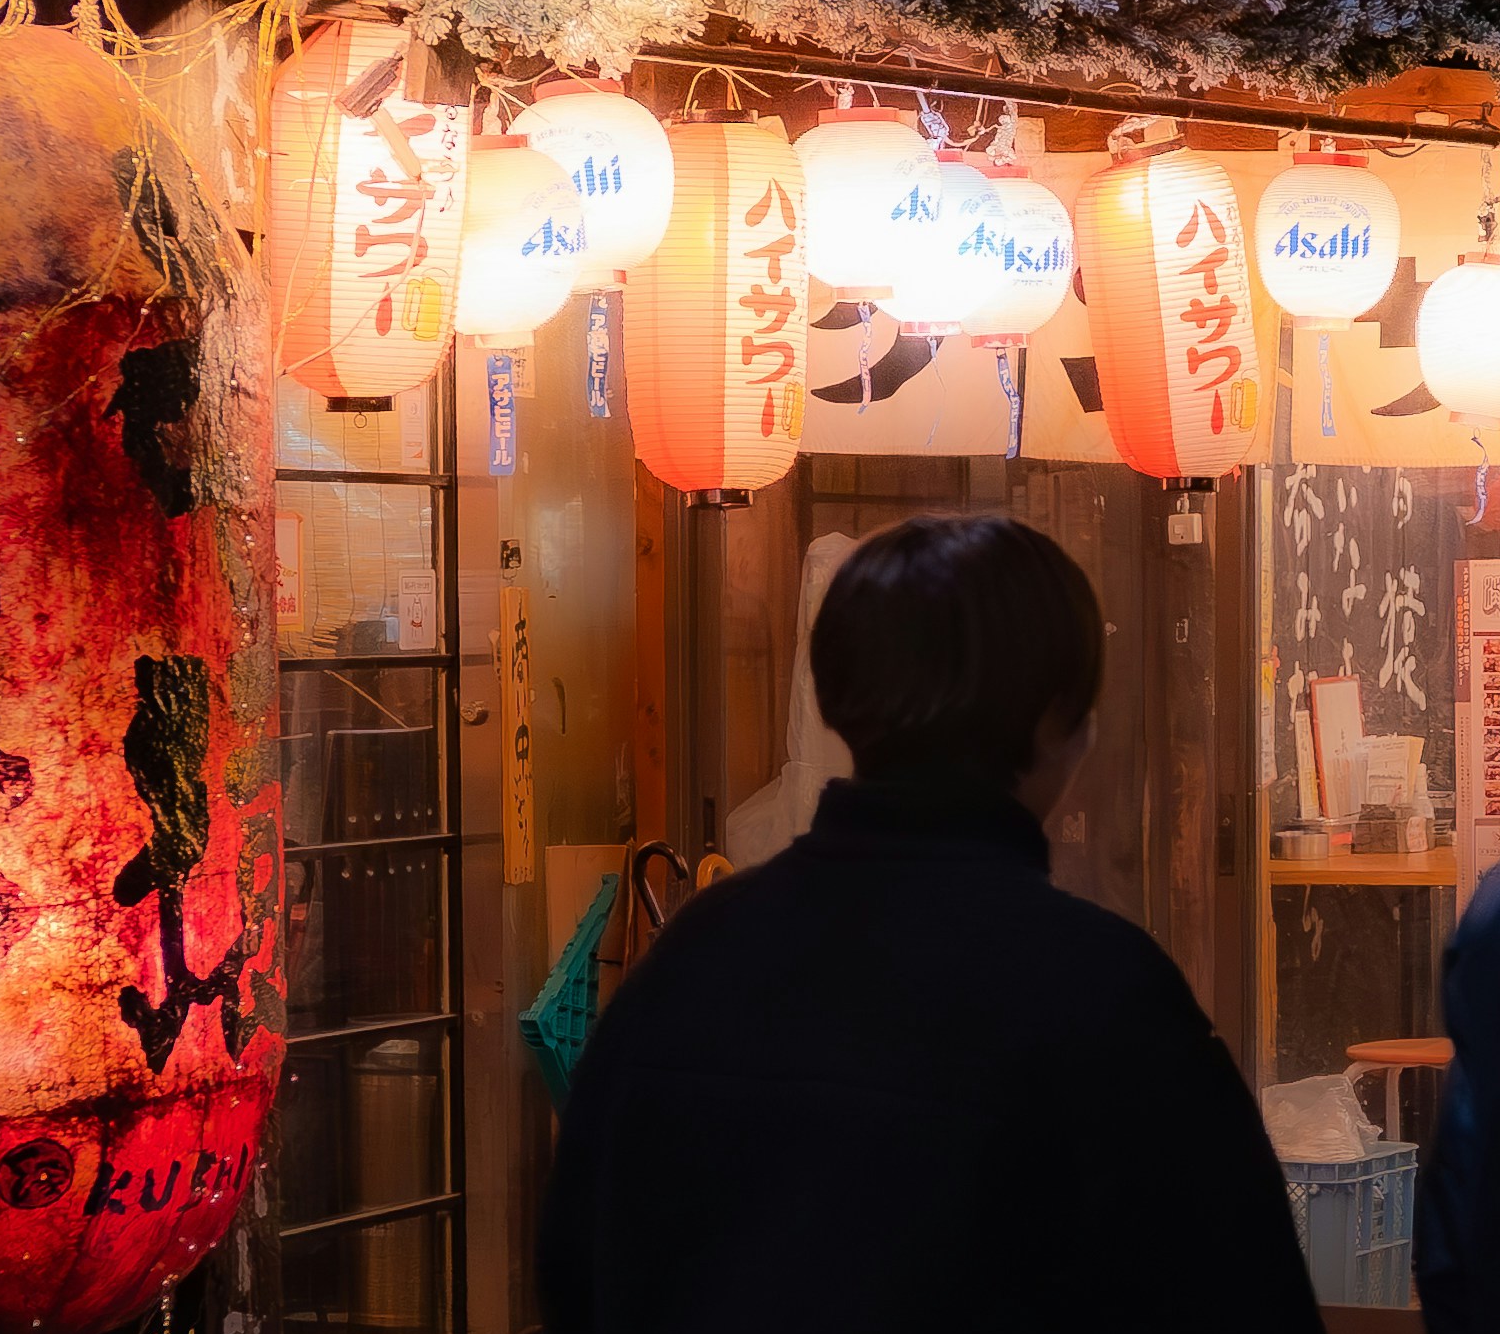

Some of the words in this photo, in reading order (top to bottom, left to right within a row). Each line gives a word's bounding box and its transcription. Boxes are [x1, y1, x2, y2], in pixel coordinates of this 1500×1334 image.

[739, 176, 797, 438] ハイサワー
[1172, 196, 1243, 436] ハイサワー
[1273, 220, 1372, 260] Asahi
[490, 372, 513, 467] アサヒビール
